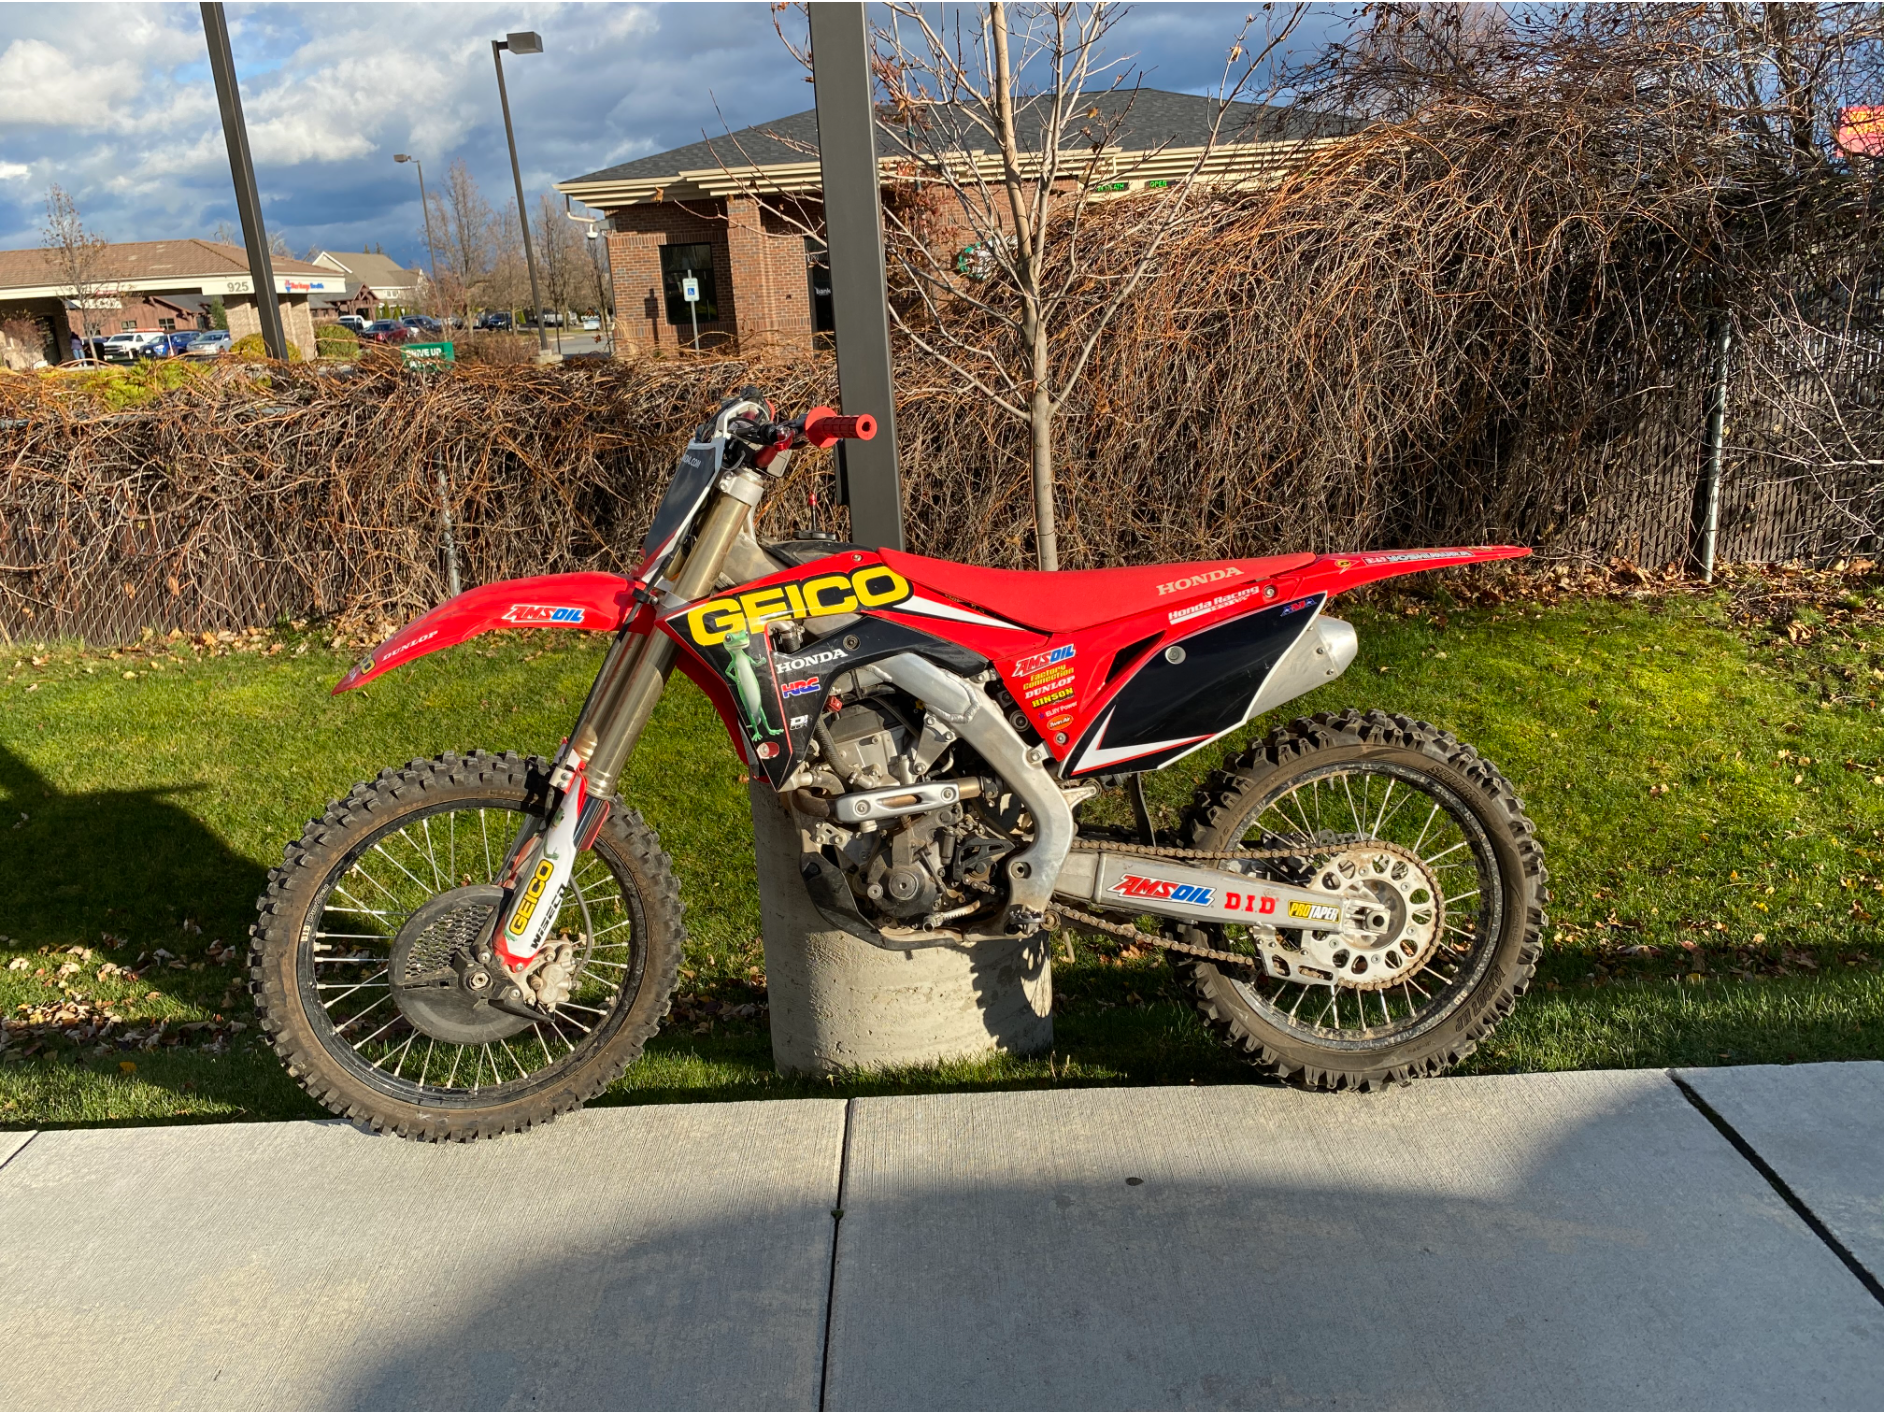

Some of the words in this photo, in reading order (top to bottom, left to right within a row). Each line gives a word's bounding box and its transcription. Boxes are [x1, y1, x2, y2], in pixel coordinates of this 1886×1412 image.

[1149, 180, 1167, 188] OPEN
[227, 281, 249, 293] 925
[1156, 567, 1244, 596] HONDA
[502, 604, 585, 623] AMSOIL
[688, 565, 910, 646] GEICO
[1168, 600, 1212, 621] Honda
[1213, 586, 1260, 605] Racing
[381, 629, 439, 662] DUNLOP
[775, 648, 849, 674] HONDA
[1011, 643, 1076, 678] AMSOIL
[781, 676, 821, 699] HRC
[1025, 675, 1076, 699] DUNLOP
[1031, 687, 1075, 709] HINSON
[508, 857, 555, 936] GEICO
[1111, 874, 1215, 906] AMSOIL
